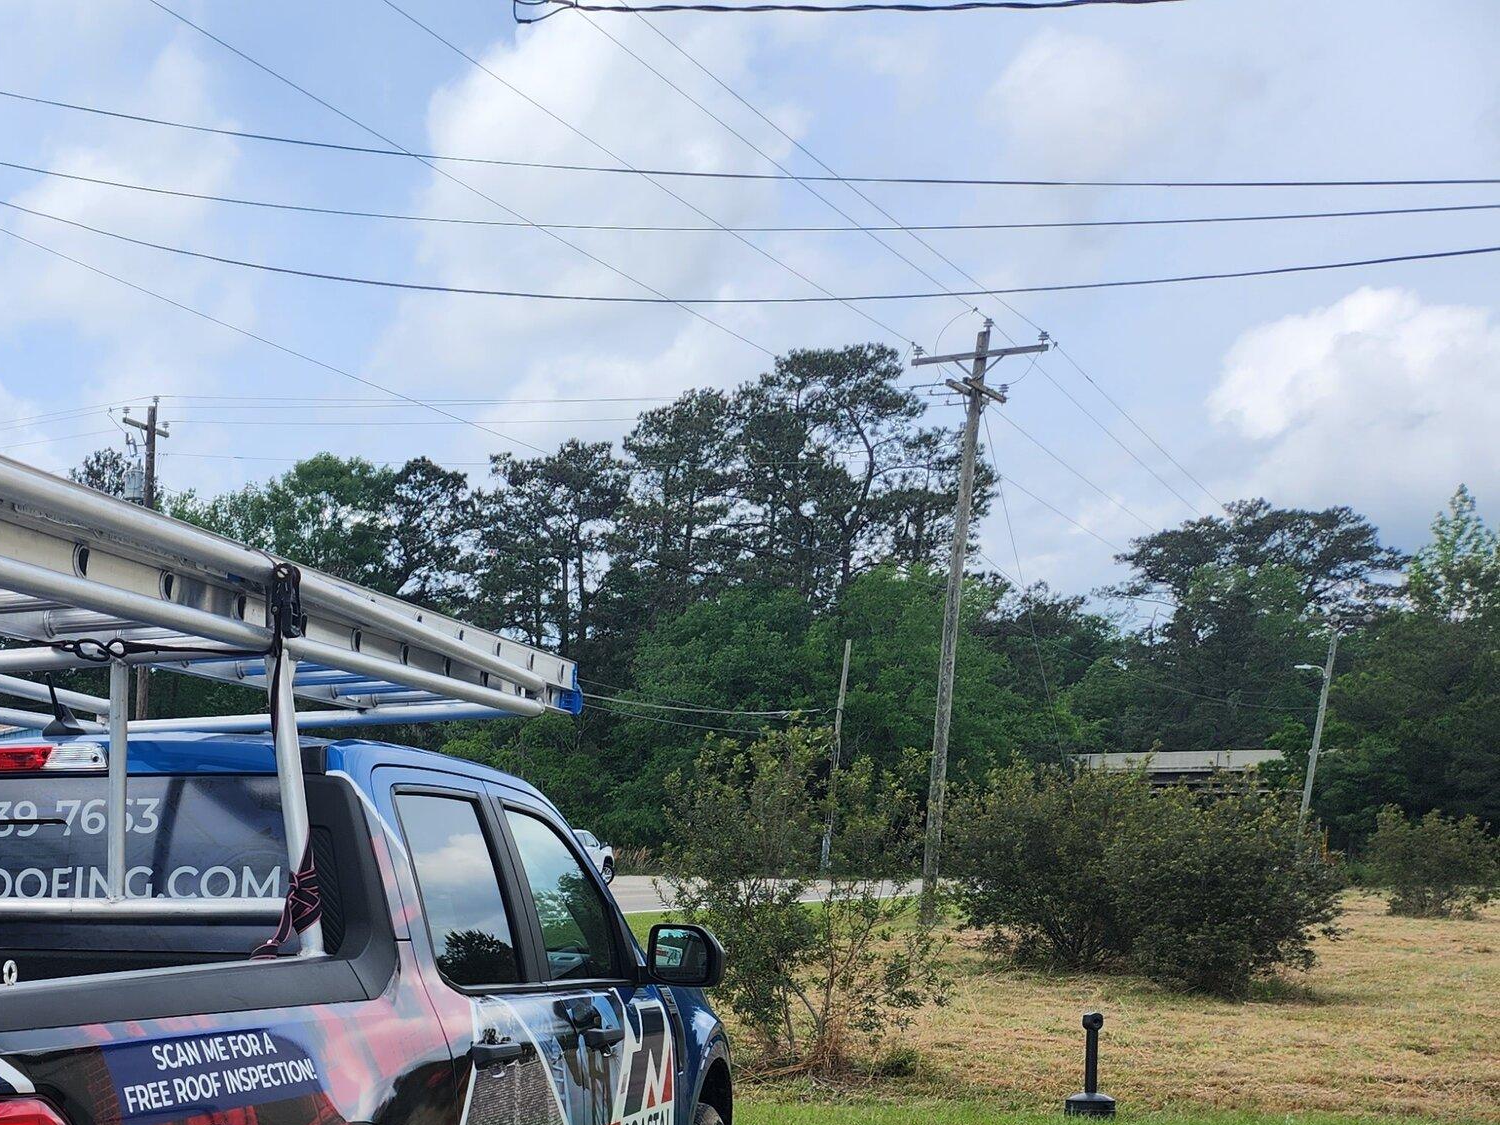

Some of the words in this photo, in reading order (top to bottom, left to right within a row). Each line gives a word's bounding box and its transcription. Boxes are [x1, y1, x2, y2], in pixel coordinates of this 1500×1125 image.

[151, 1040, 202, 1071] SCAN
[201, 1036, 230, 1062] ME
[231, 1033, 261, 1059] FOR
[260, 1032, 278, 1054] A
[123, 1080, 177, 1113] FREE
[176, 1072, 222, 1104] ROOF
[223, 1058, 318, 1096] INSPECTION!
